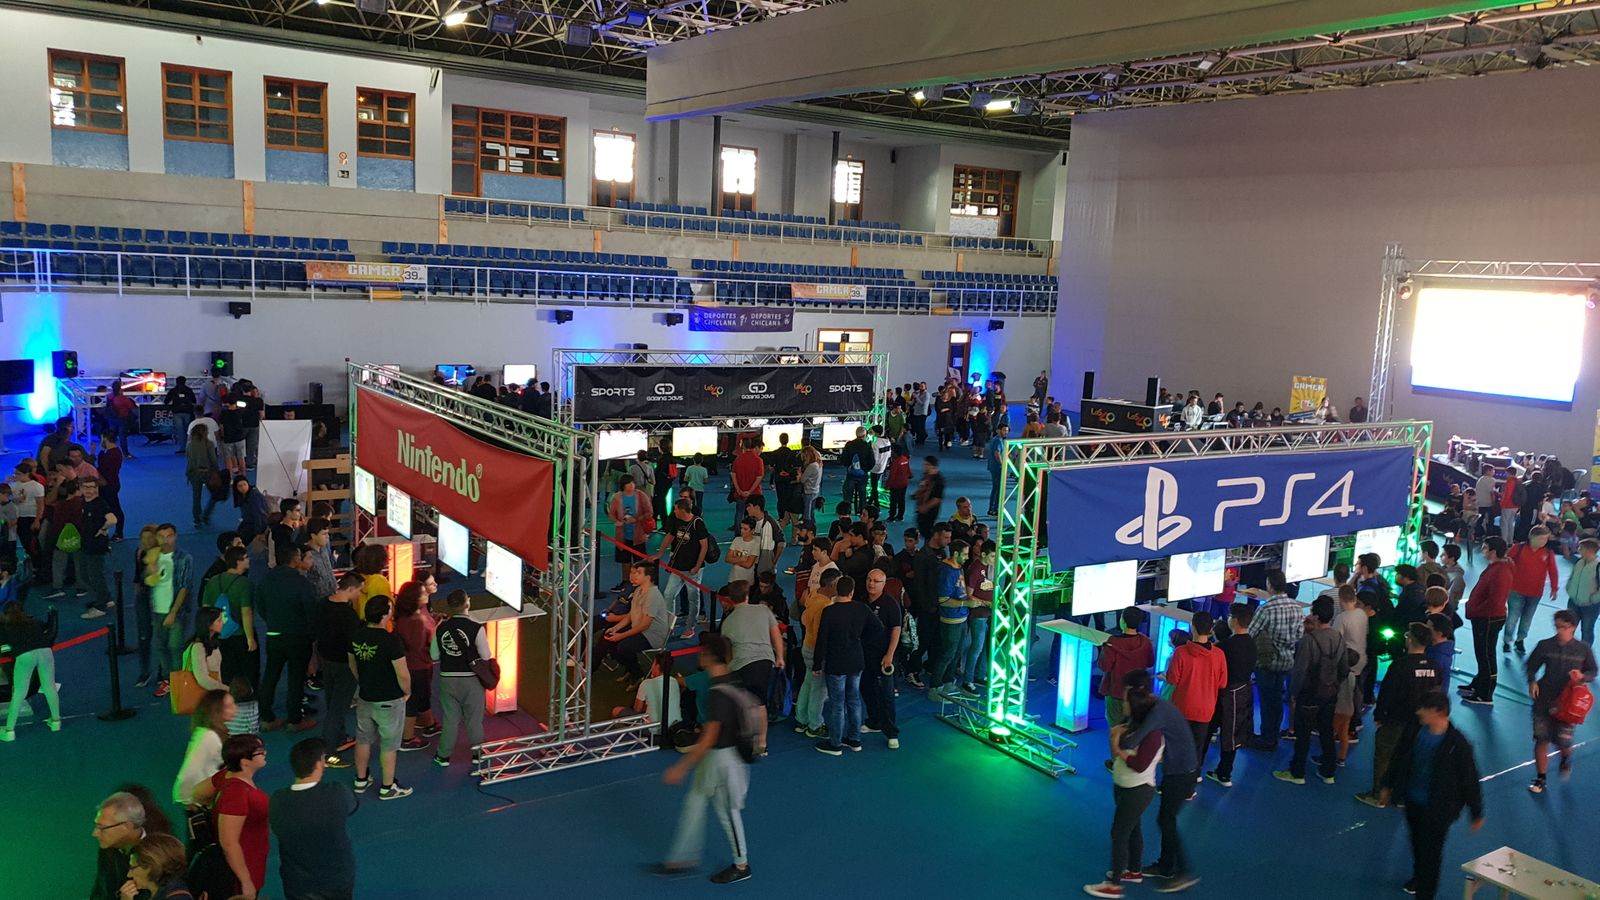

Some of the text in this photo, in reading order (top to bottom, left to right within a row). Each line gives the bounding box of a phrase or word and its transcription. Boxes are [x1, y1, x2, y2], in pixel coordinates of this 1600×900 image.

[348, 264, 400, 276] GAMER
[404, 271, 419, 280] 39
[851, 290, 860, 298] 39
[591, 387, 636, 397] SPORTS
[828, 384, 863, 393] SPORTS
[154, 410, 174, 419] BEA
[1213, 470, 1355, 532] PS4
